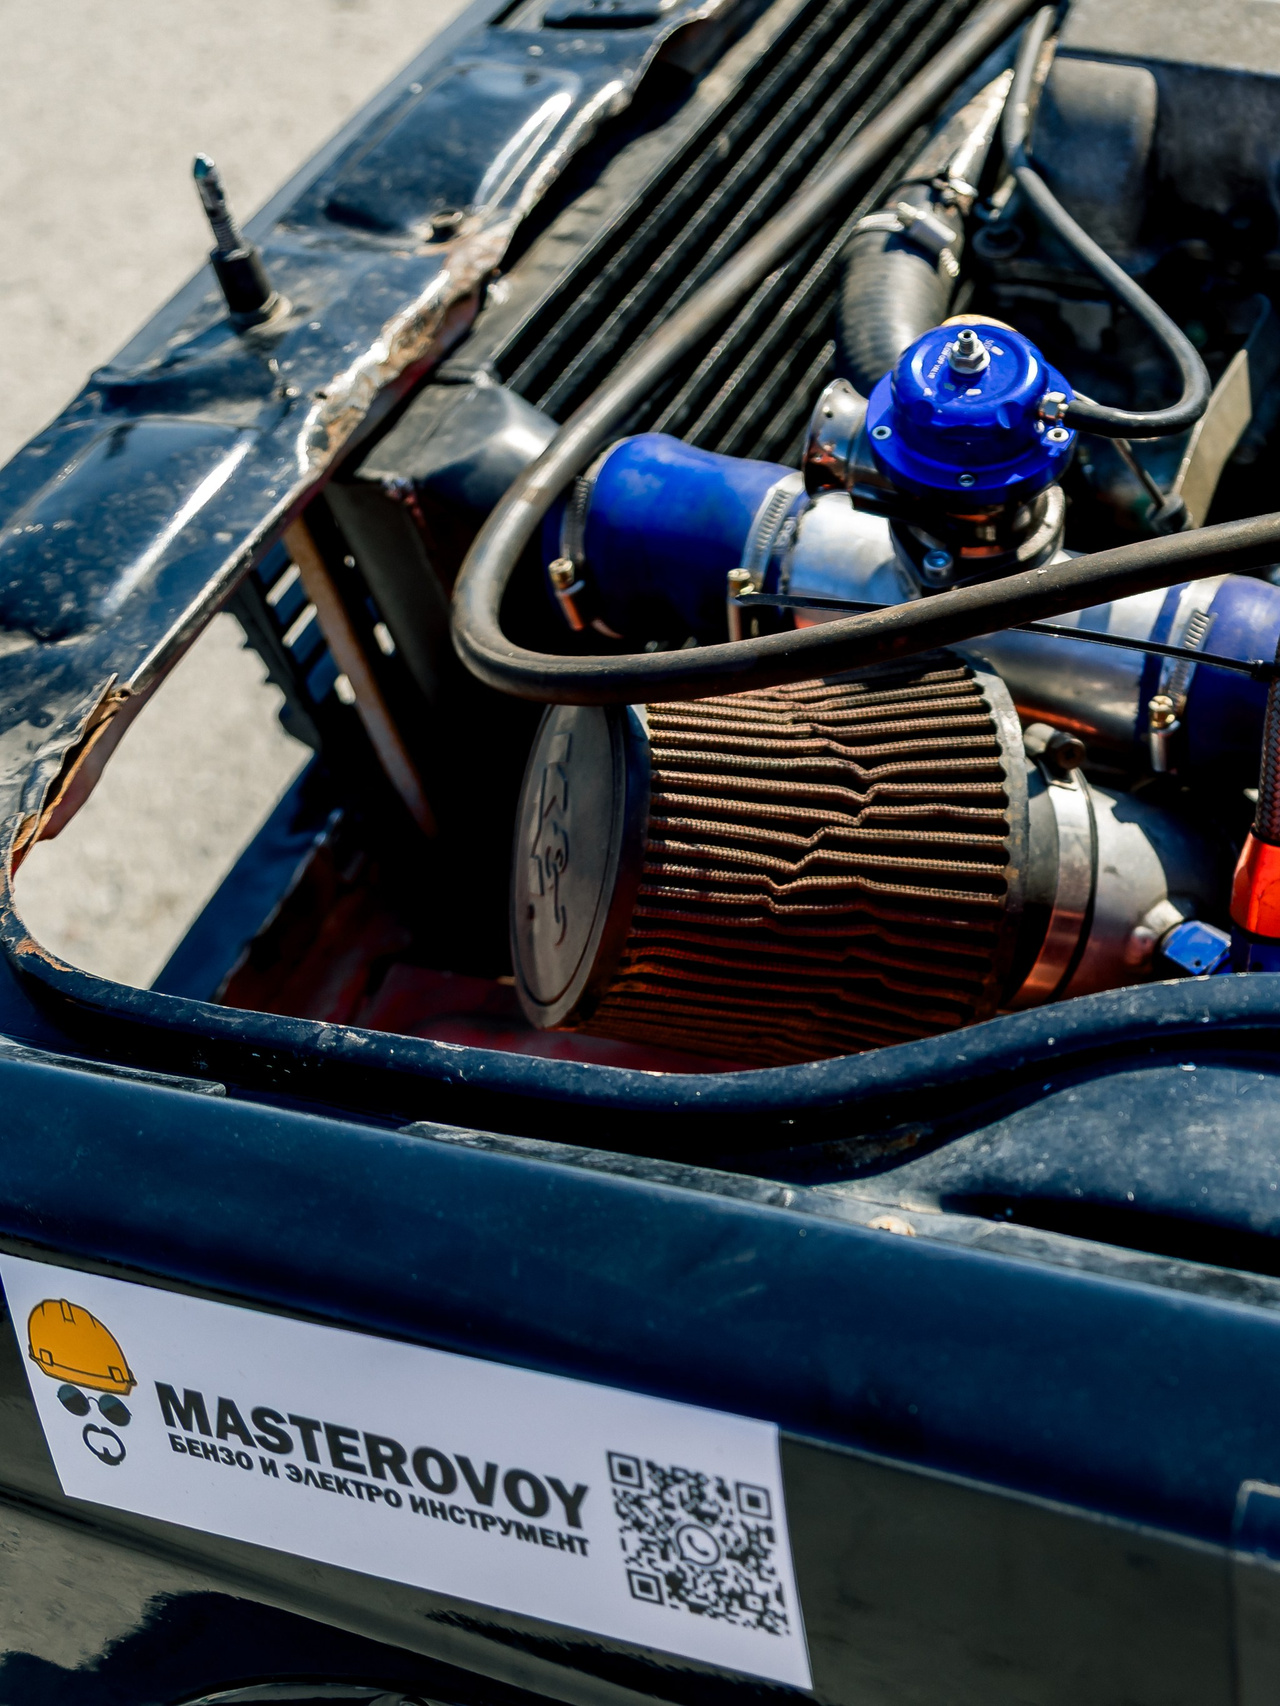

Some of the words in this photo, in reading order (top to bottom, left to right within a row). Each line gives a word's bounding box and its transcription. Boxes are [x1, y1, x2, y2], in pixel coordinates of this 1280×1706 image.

[154, 1380, 589, 1530] MASTEROVOY
[167, 1432, 254, 1471] БЕНЗО
[258, 1455, 280, 1479] И
[284, 1463, 403, 1508] ЭЛЕКТРО
[408, 1494, 589, 1557] ИНСТРУМЕНТ
